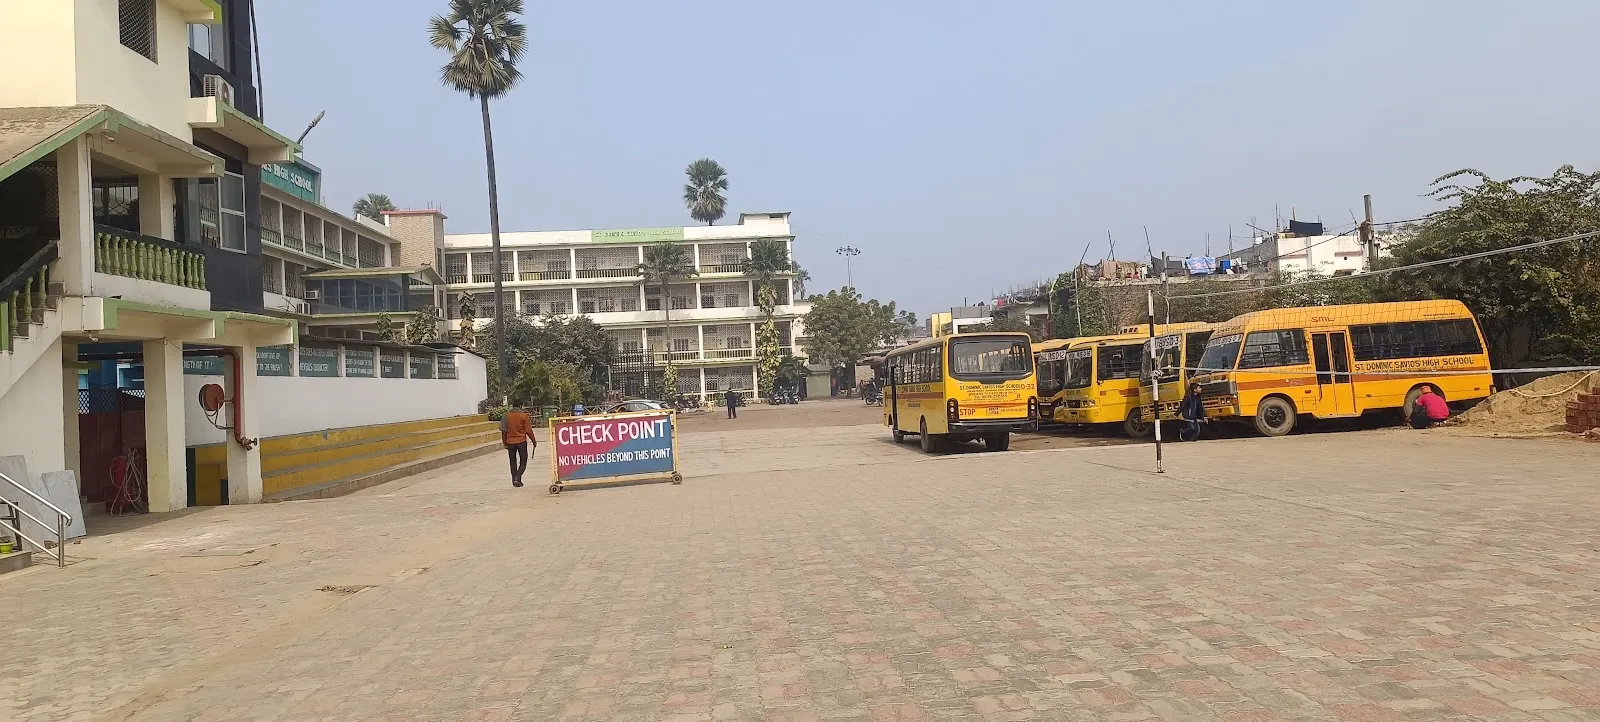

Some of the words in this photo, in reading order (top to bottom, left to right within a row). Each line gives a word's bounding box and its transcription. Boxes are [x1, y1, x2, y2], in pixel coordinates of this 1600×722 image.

[274, 164, 288, 181] HIGH
[290, 172, 312, 192] SCHOOL
[196, 360, 203, 369] OF
[204, 361, 210, 369] IT
[1366, 361, 1394, 370] DOMINIC
[1442, 356, 1474, 365] SCHOOL
[558, 424, 614, 445] CHECK
[618, 419, 667, 440] POINT
[559, 456, 570, 466] NO
[571, 453, 605, 465] VEHICLES
[607, 452, 633, 463] BEYOND
[634, 450, 648, 461] THIS
[651, 448, 670, 459] POINT
